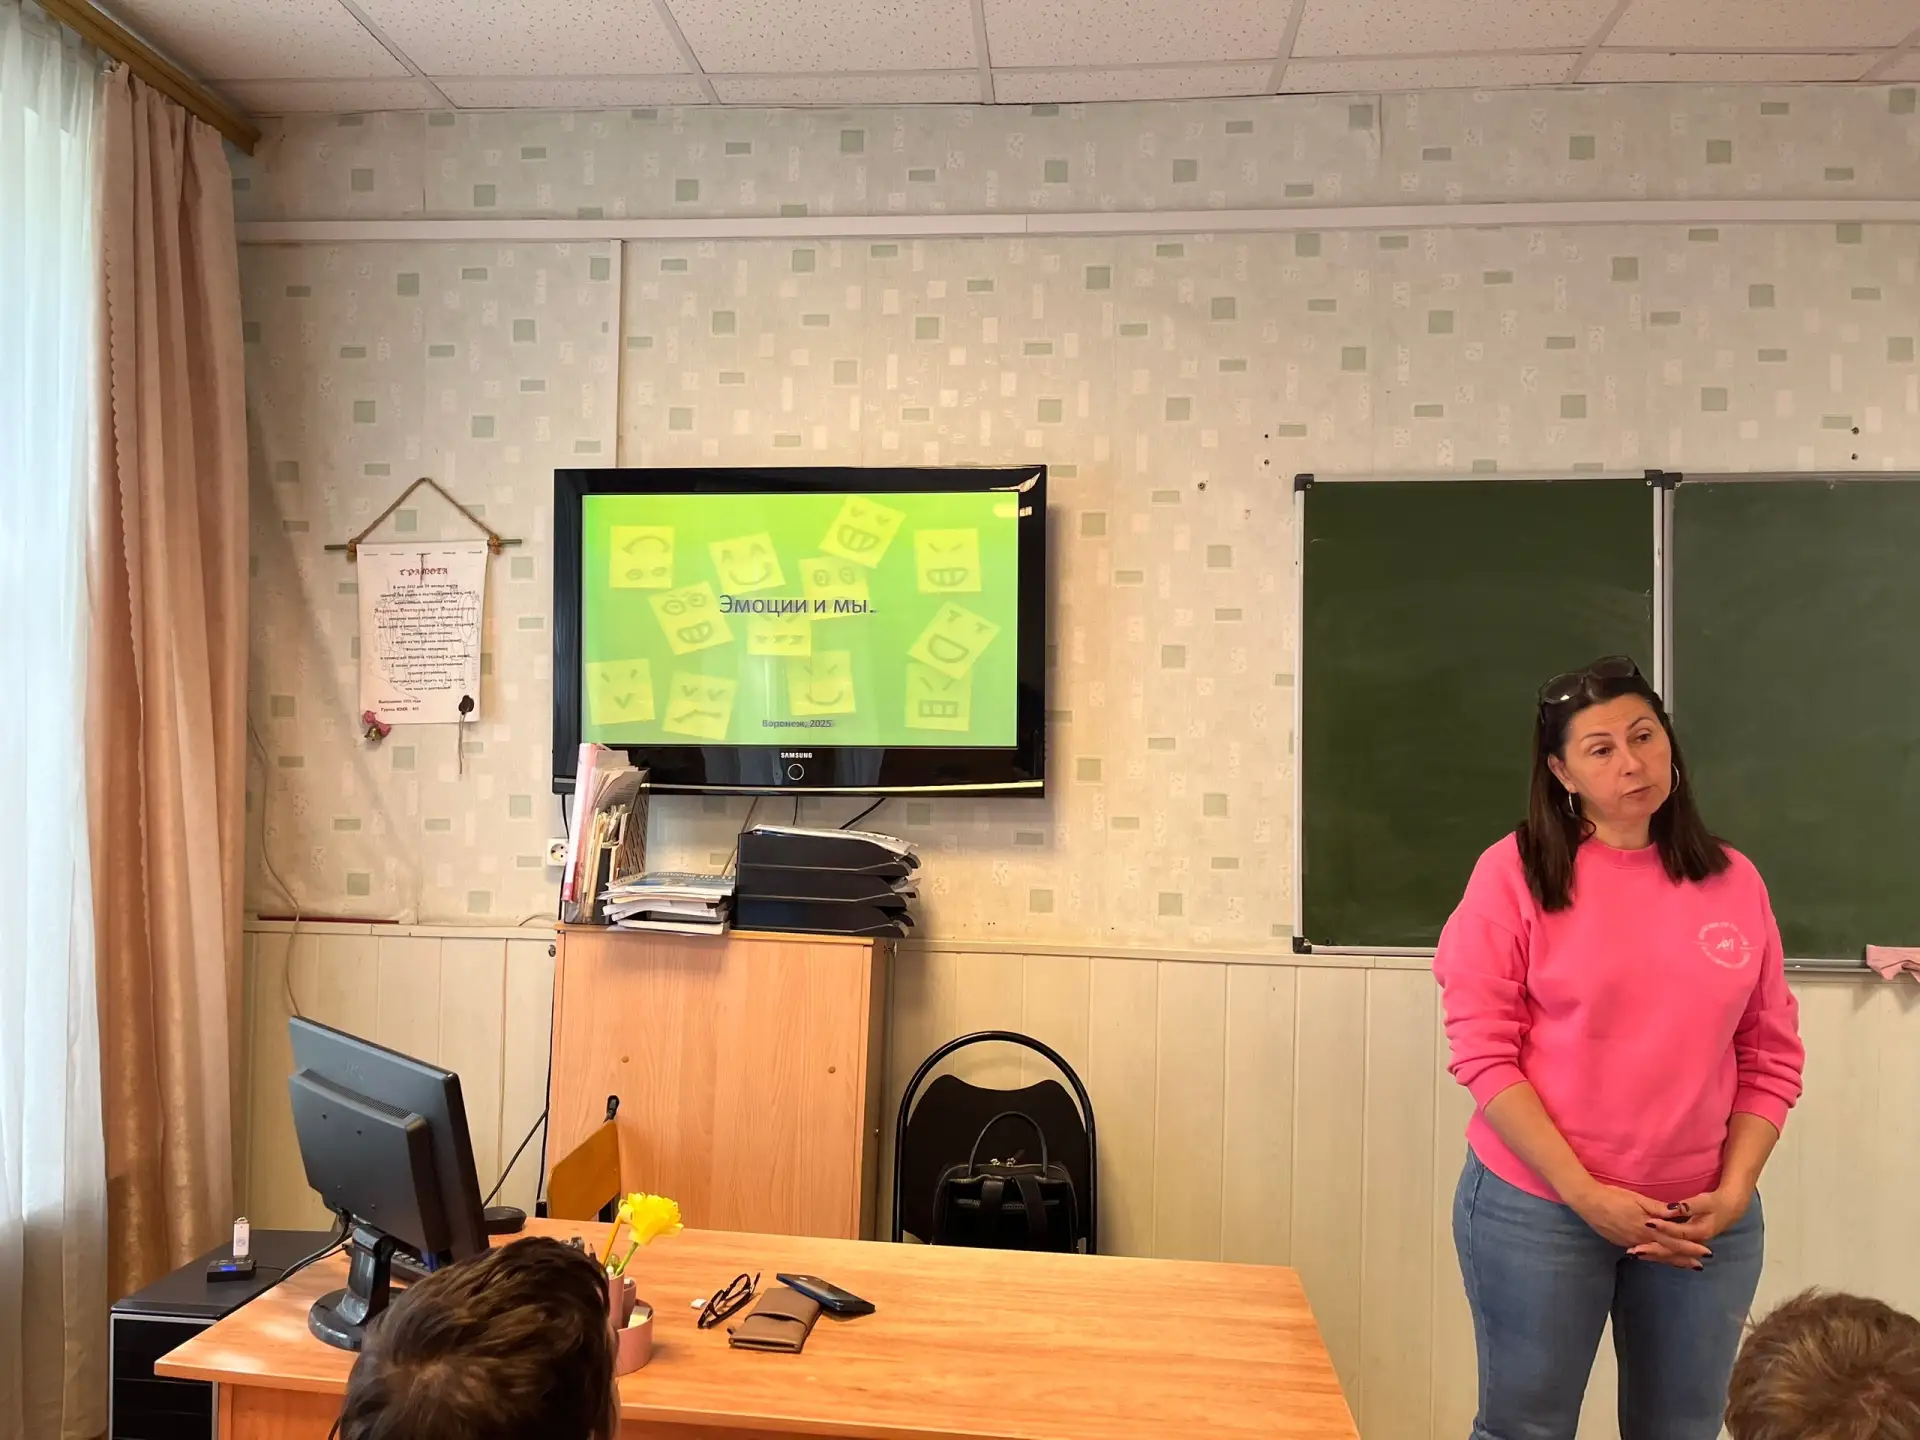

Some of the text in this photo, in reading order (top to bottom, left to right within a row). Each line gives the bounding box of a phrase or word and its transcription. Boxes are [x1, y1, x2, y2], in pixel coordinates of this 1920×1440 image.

[719, 594, 807, 617] Эмоции
[814, 599, 826, 613] и
[762, 719, 833, 728] Воронеж, 2025
